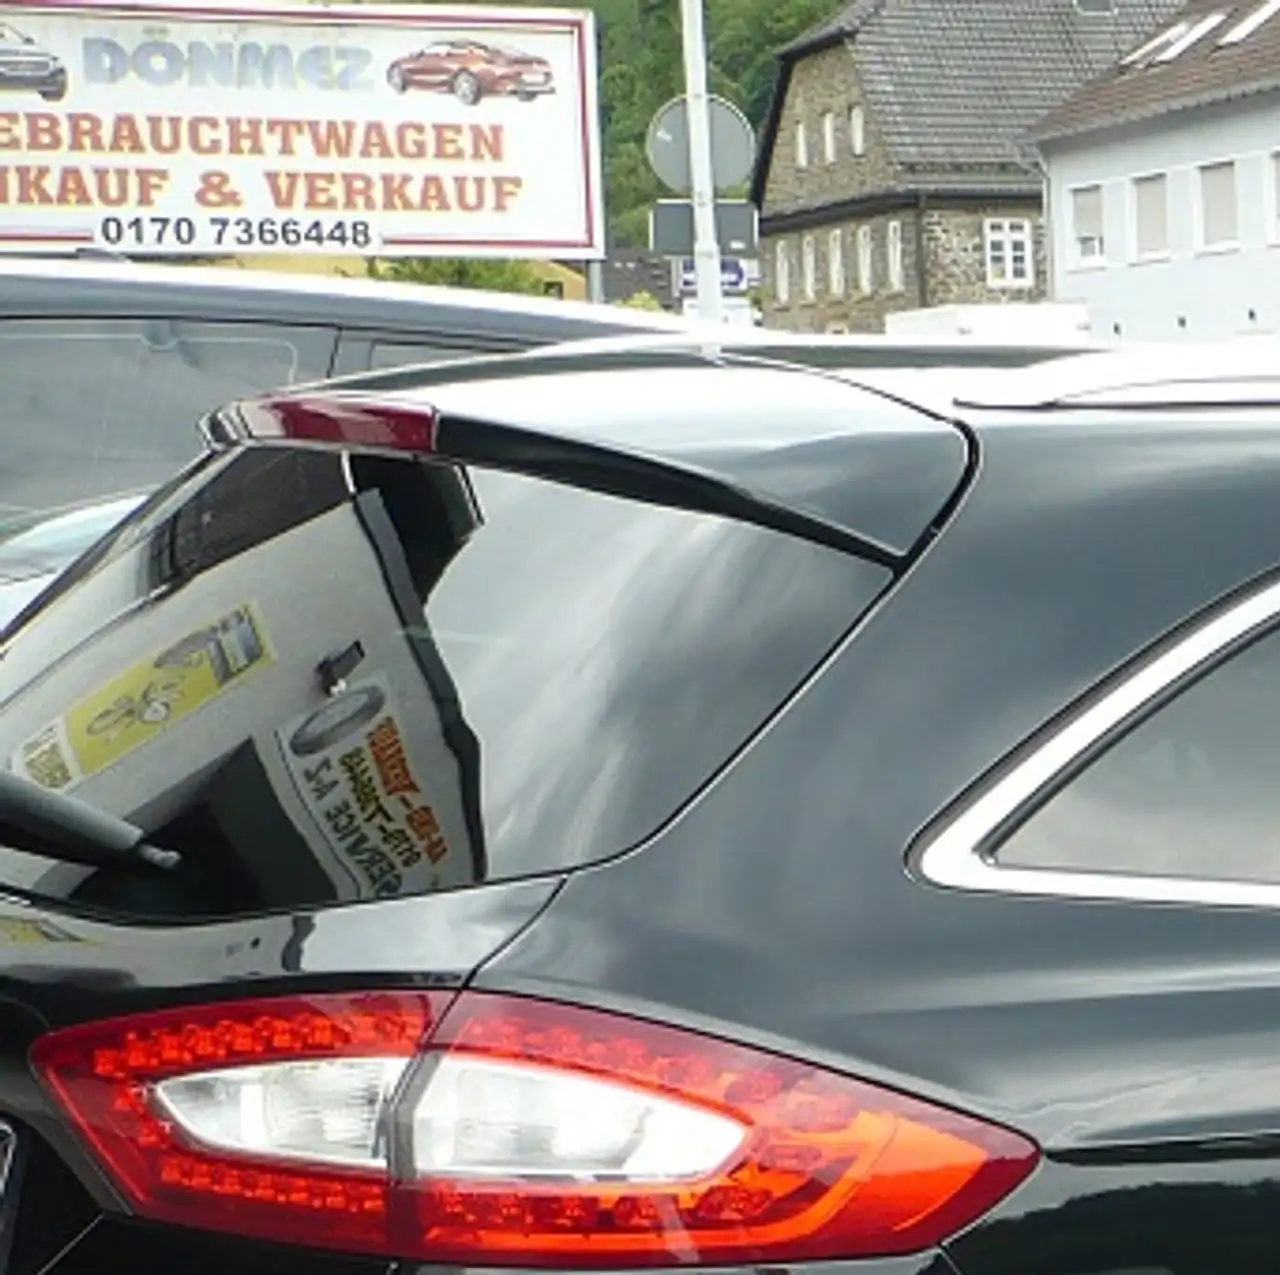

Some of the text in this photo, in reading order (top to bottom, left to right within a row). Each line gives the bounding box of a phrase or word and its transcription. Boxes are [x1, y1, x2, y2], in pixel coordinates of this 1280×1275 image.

[82, 27, 374, 92] DÖNMEZ
[0, 165, 524, 213] KAUF & VERKAUF
[101, 216, 372, 249] 0170 7366448
